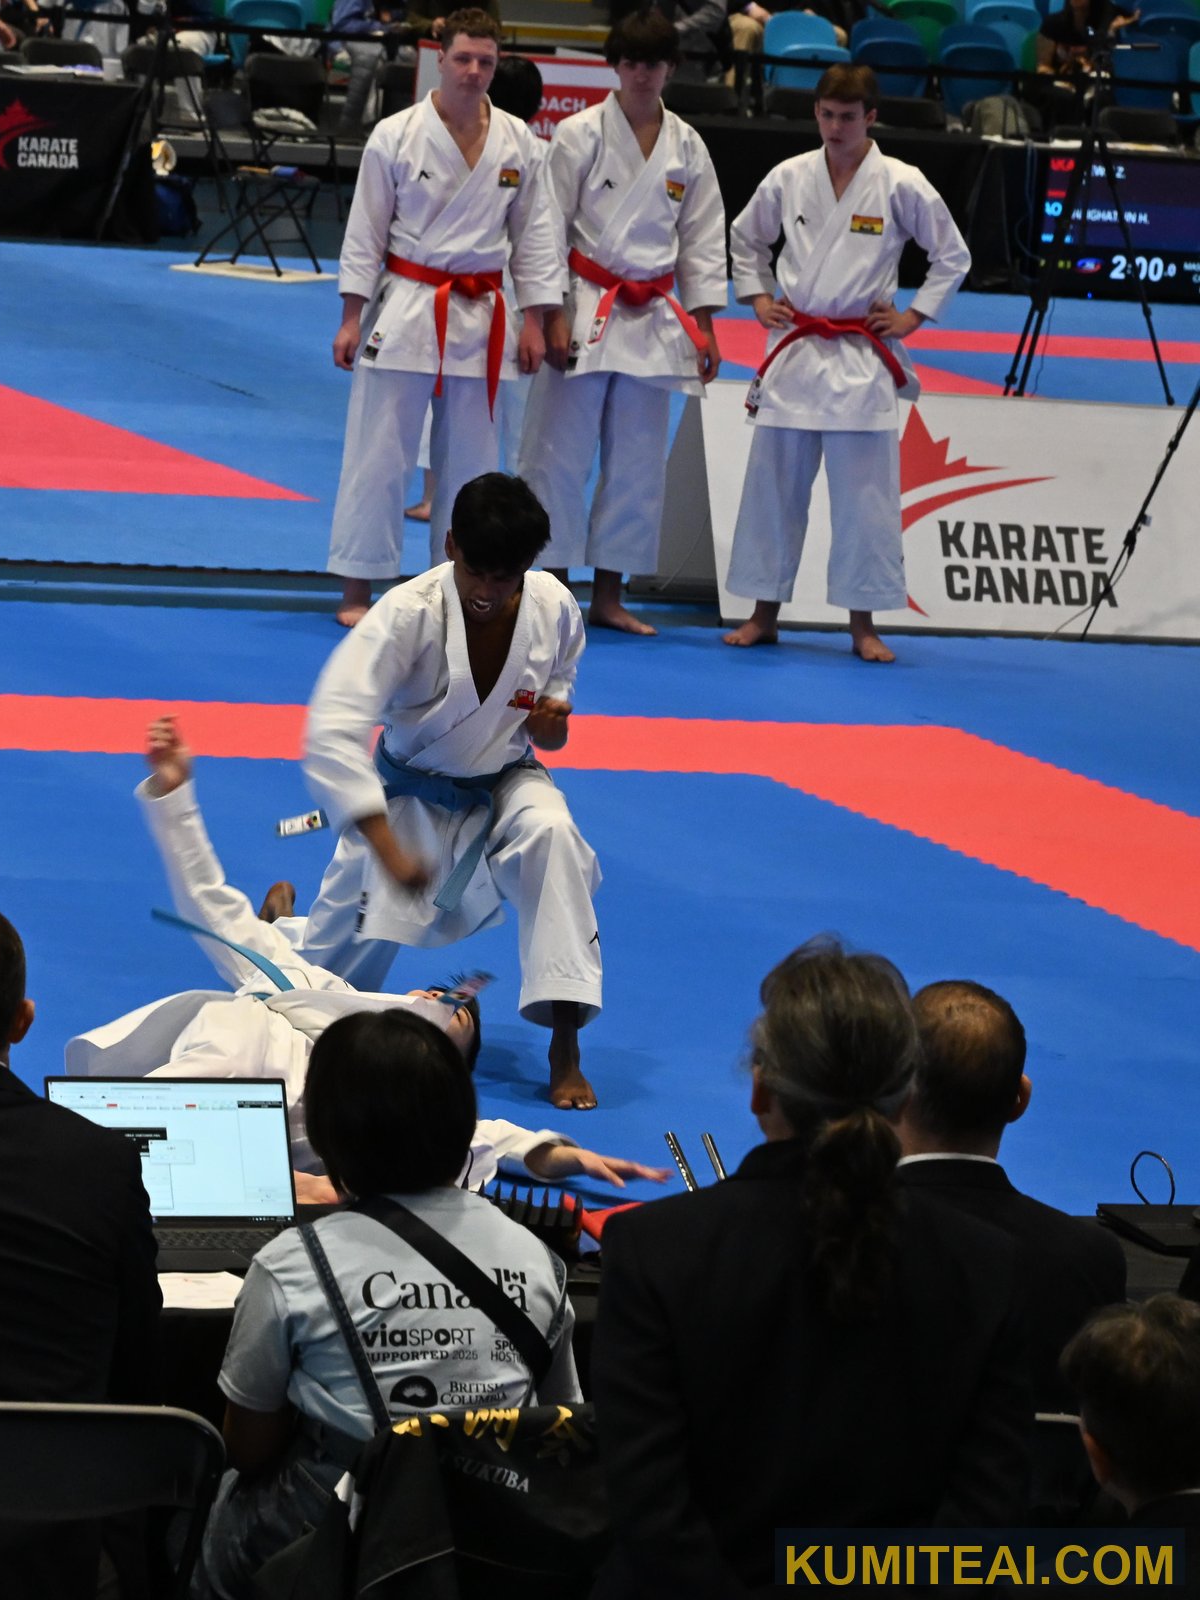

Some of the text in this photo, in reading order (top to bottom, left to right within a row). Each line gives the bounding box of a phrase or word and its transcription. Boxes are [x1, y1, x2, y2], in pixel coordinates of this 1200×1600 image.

[540, 96, 586, 112] ACH
[17, 152, 78, 168] CANADA
[18, 137, 78, 153] KARATE
[938, 519, 1108, 565] KARATE
[944, 564, 1118, 608] CANADA
[362, 1267, 531, 1314] Canaa
